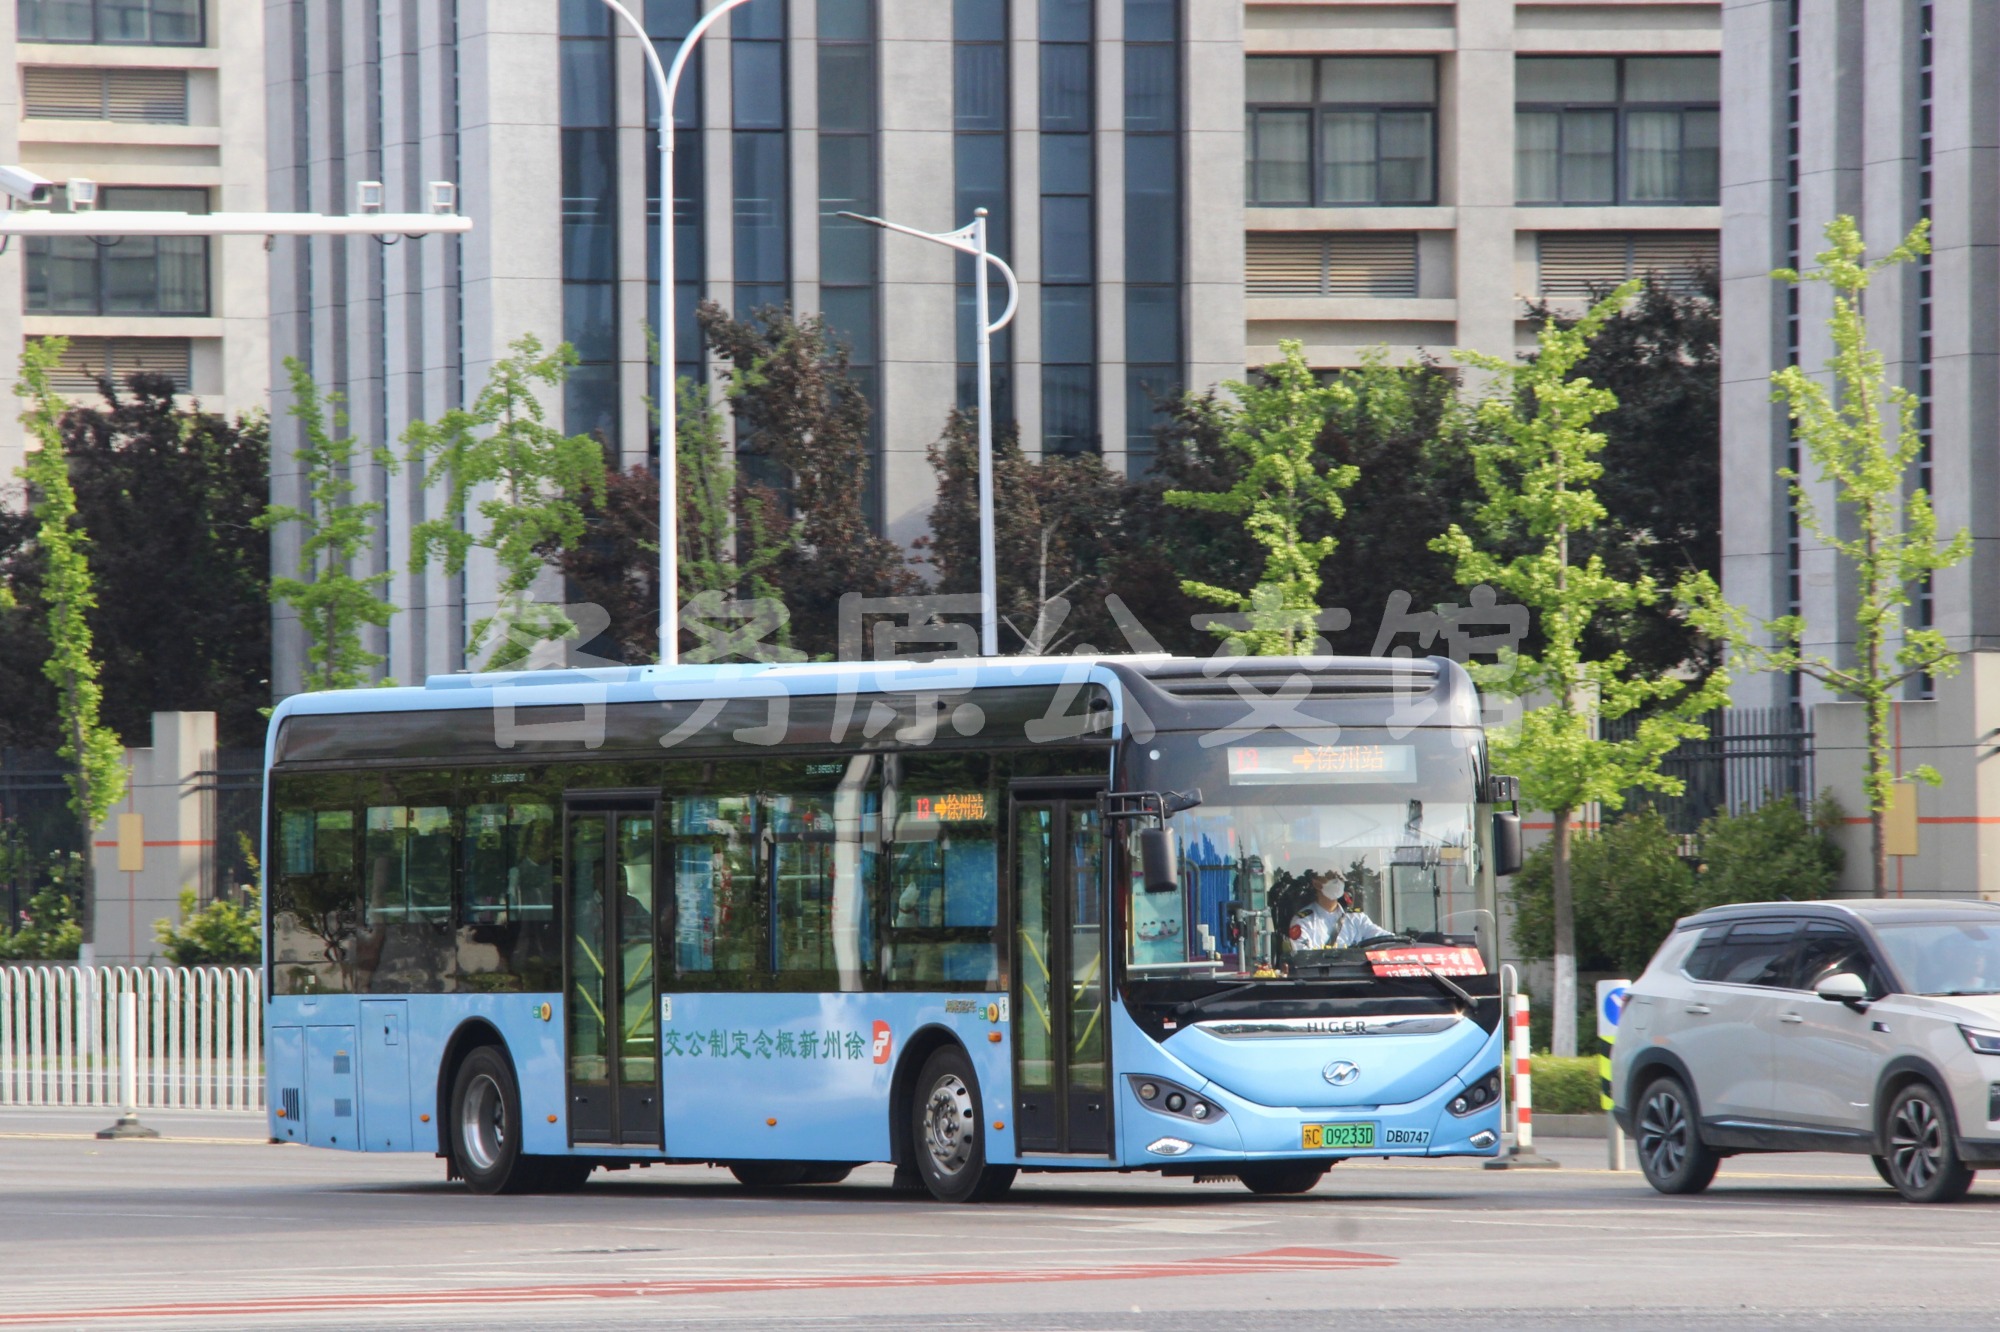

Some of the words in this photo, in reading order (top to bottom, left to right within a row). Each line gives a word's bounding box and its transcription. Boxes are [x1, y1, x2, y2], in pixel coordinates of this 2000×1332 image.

[1236, 748, 1259, 771] 13
[1315, 745, 1384, 771] 徐州站
[917, 797, 930, 819] 13
[947, 793, 984, 820] 徐州站
[1307, 1021, 1366, 1033] HIGER
[1386, 1130, 1429, 1143] DB0747
